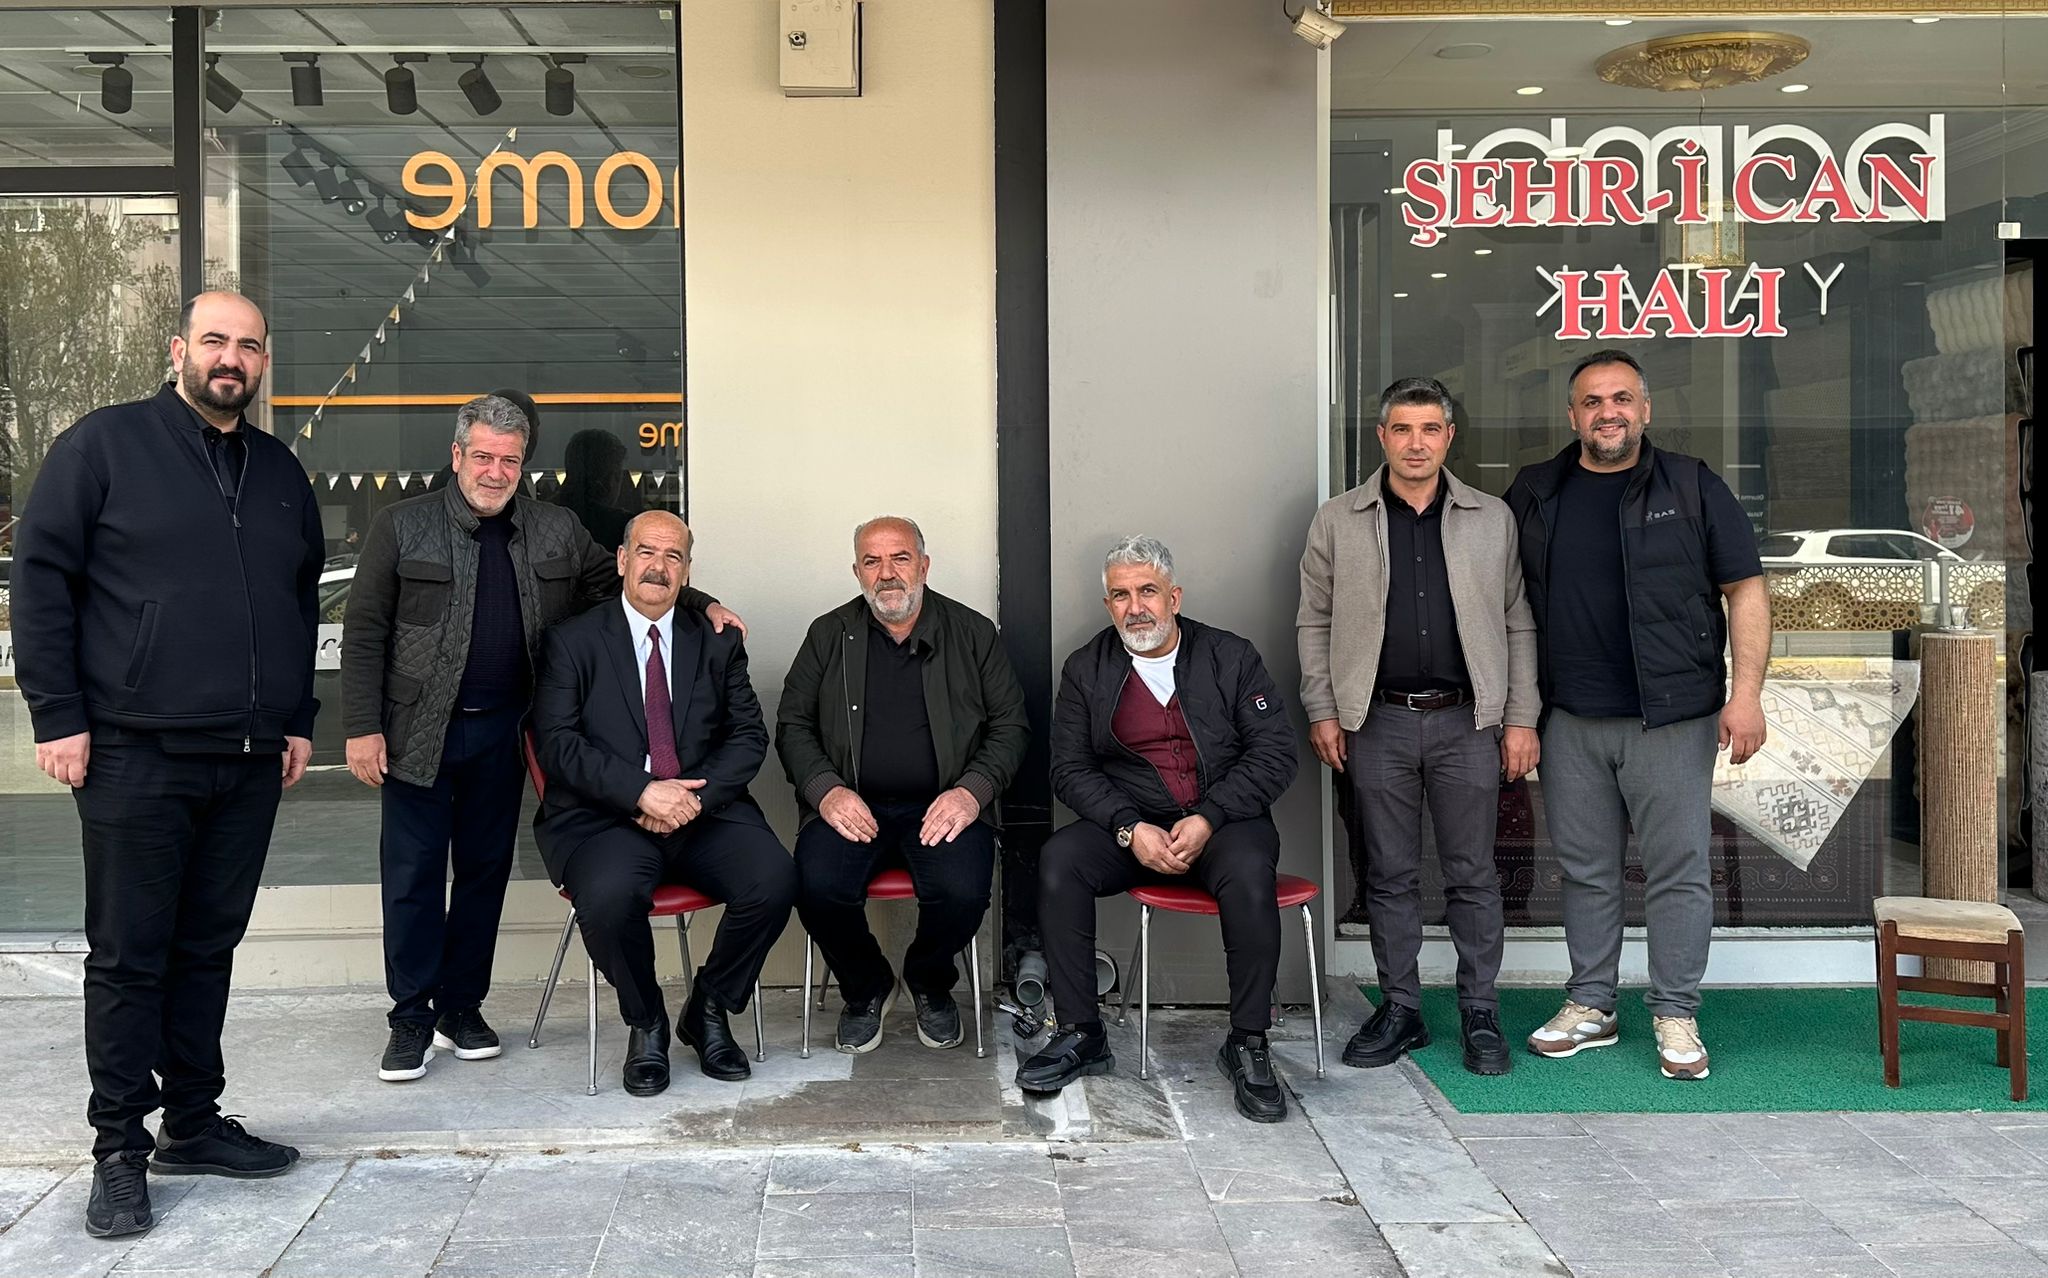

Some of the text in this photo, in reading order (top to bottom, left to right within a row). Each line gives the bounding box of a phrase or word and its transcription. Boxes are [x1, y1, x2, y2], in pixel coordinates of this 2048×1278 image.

[1401, 138, 1938, 248] ŞEHR-İ CAN
[1553, 267, 1788, 340] HALI
